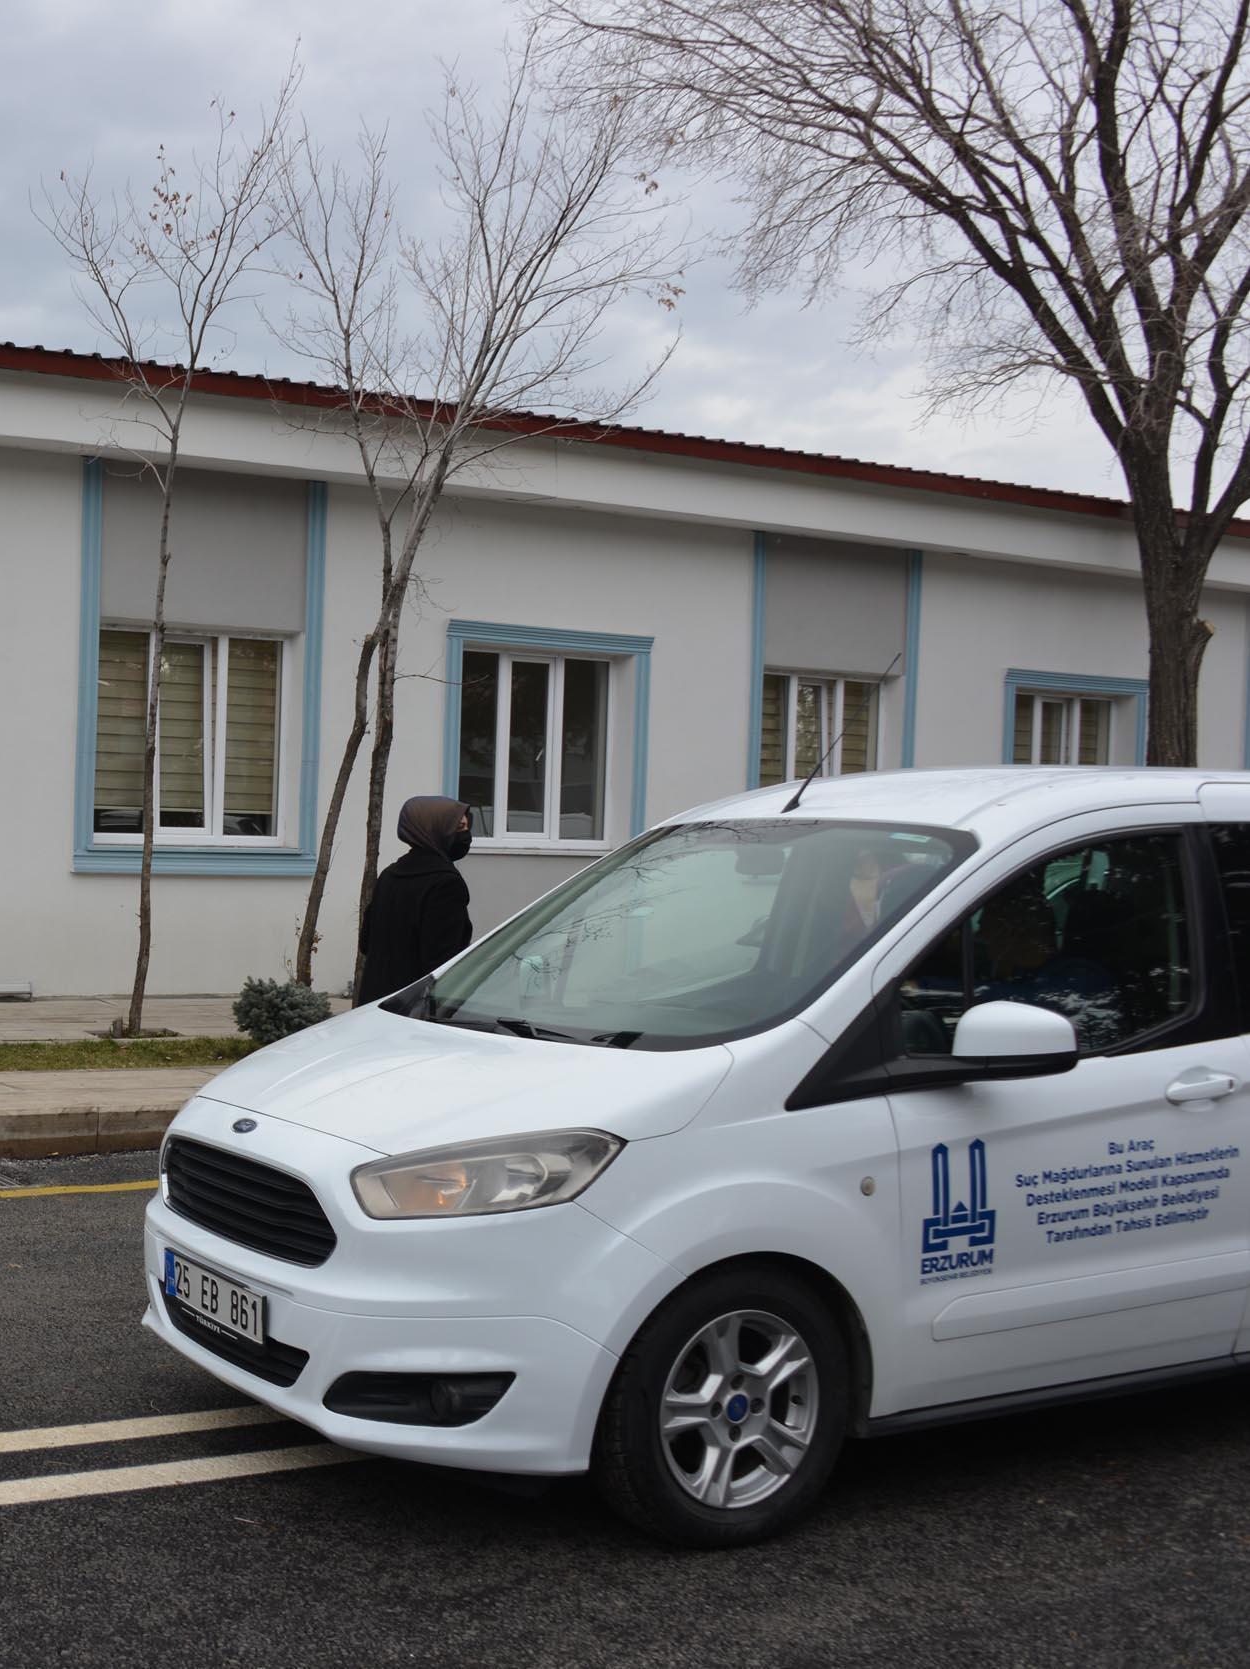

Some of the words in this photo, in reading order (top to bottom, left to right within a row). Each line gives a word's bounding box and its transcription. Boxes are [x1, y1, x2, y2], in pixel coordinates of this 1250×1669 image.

[1015, 1174, 1039, 1188] Suç
[1042, 1164, 1123, 1184] Mağdurlarına
[1126, 1155, 1172, 1173] Sunulan
[1175, 1145, 1240, 1166] Hizmetlerin
[1108, 1141, 1124, 1155] Bu
[1127, 1139, 1155, 1152] Araç
[1026, 1181, 1116, 1206] Desteklenmesi
[1118, 1175, 1159, 1194] Modeli
[1161, 1165, 1231, 1188] Kapsamında
[1037, 1208, 1090, 1225] Erzurum
[1092, 1195, 1159, 1218] Büyükşehir
[1161, 1185, 1220, 1206] Belediyesi
[1046, 1223, 1112, 1244] Tarafından
[1115, 1216, 1152, 1232] Tahsis
[920, 1248, 995, 1275] ERZURUM
[175, 1261, 190, 1298] 25
[201, 1274, 219, 1314] EB
[231, 1289, 257, 1336] 861
